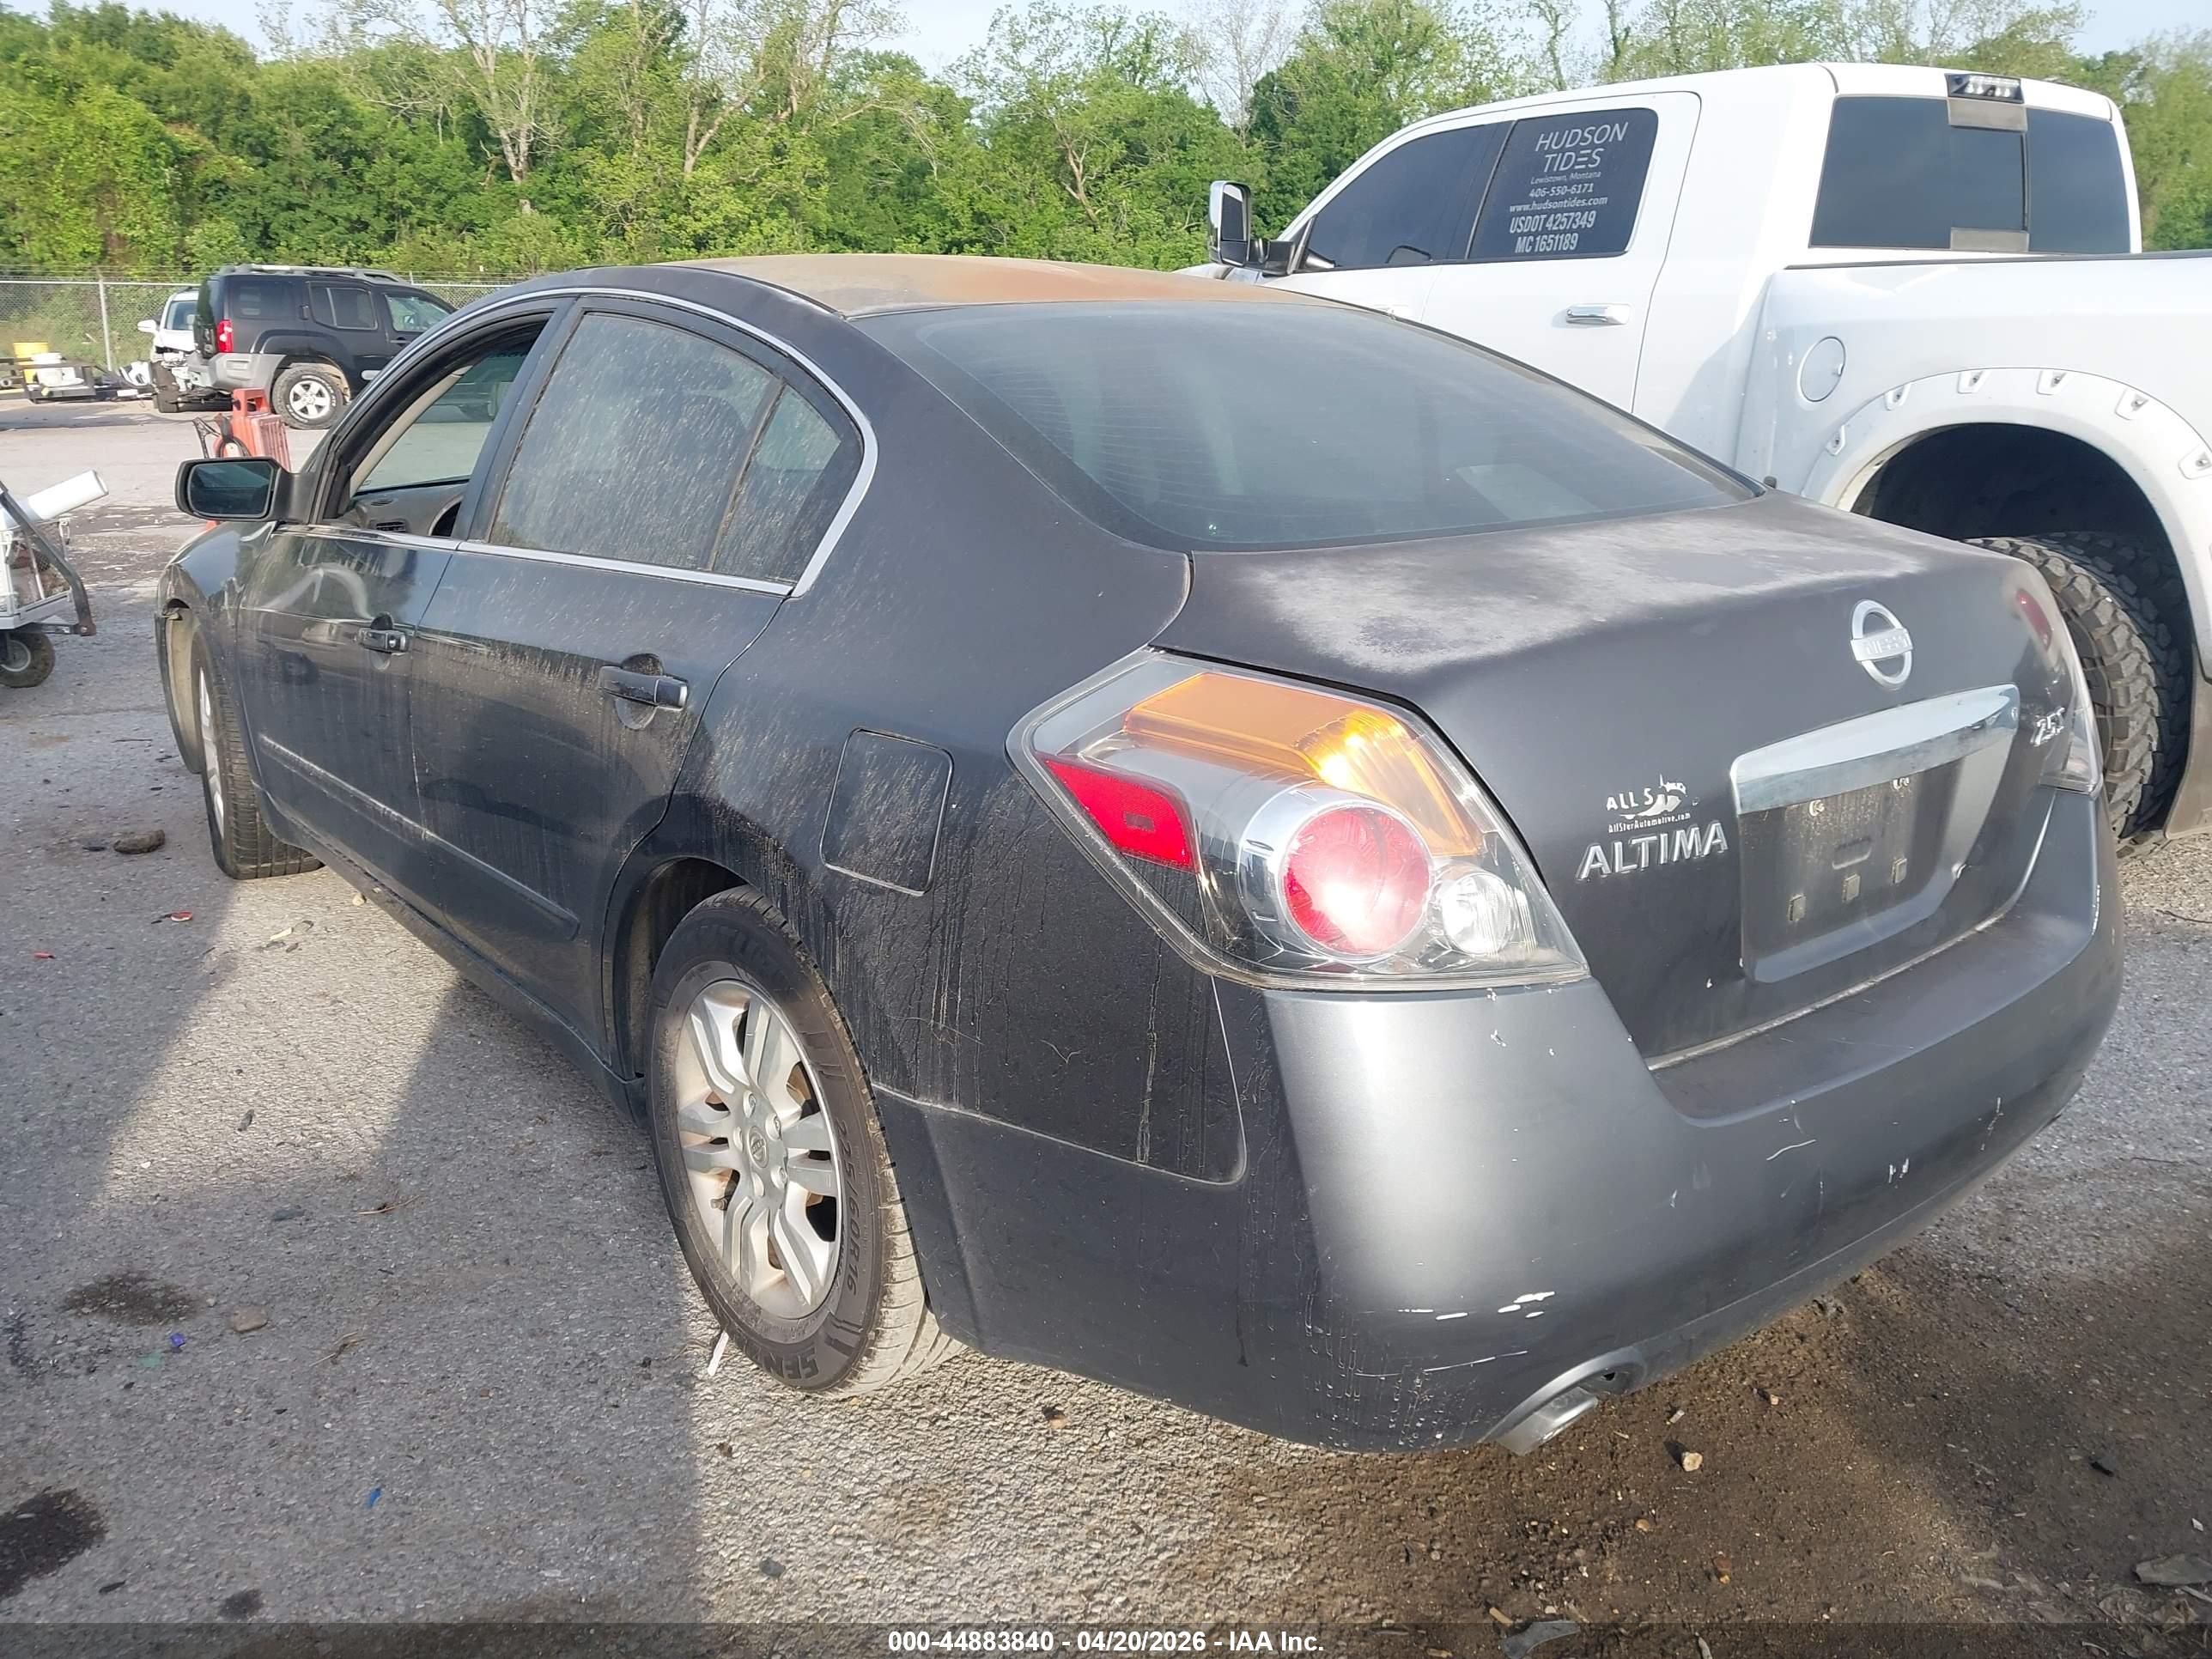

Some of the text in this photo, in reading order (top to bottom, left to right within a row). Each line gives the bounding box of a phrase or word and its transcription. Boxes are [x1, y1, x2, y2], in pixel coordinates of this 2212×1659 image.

[1535, 122, 1629, 152] HUDSON
[1544, 148, 1605, 173] TIDES
[1570, 172, 1601, 180] Montana
[1529, 183, 1595, 198] 406-550-6171
[1510, 196, 1608, 213] www.hudsontides.com
[1510, 210, 1596, 234] USDOT 4257349
[1515, 233, 1579, 253] MC 1651189
[1606, 791, 1638, 811] ALL
[1577, 821, 1729, 880] ALTIMA
[836, 1118, 860, 1296] 225/60R16
